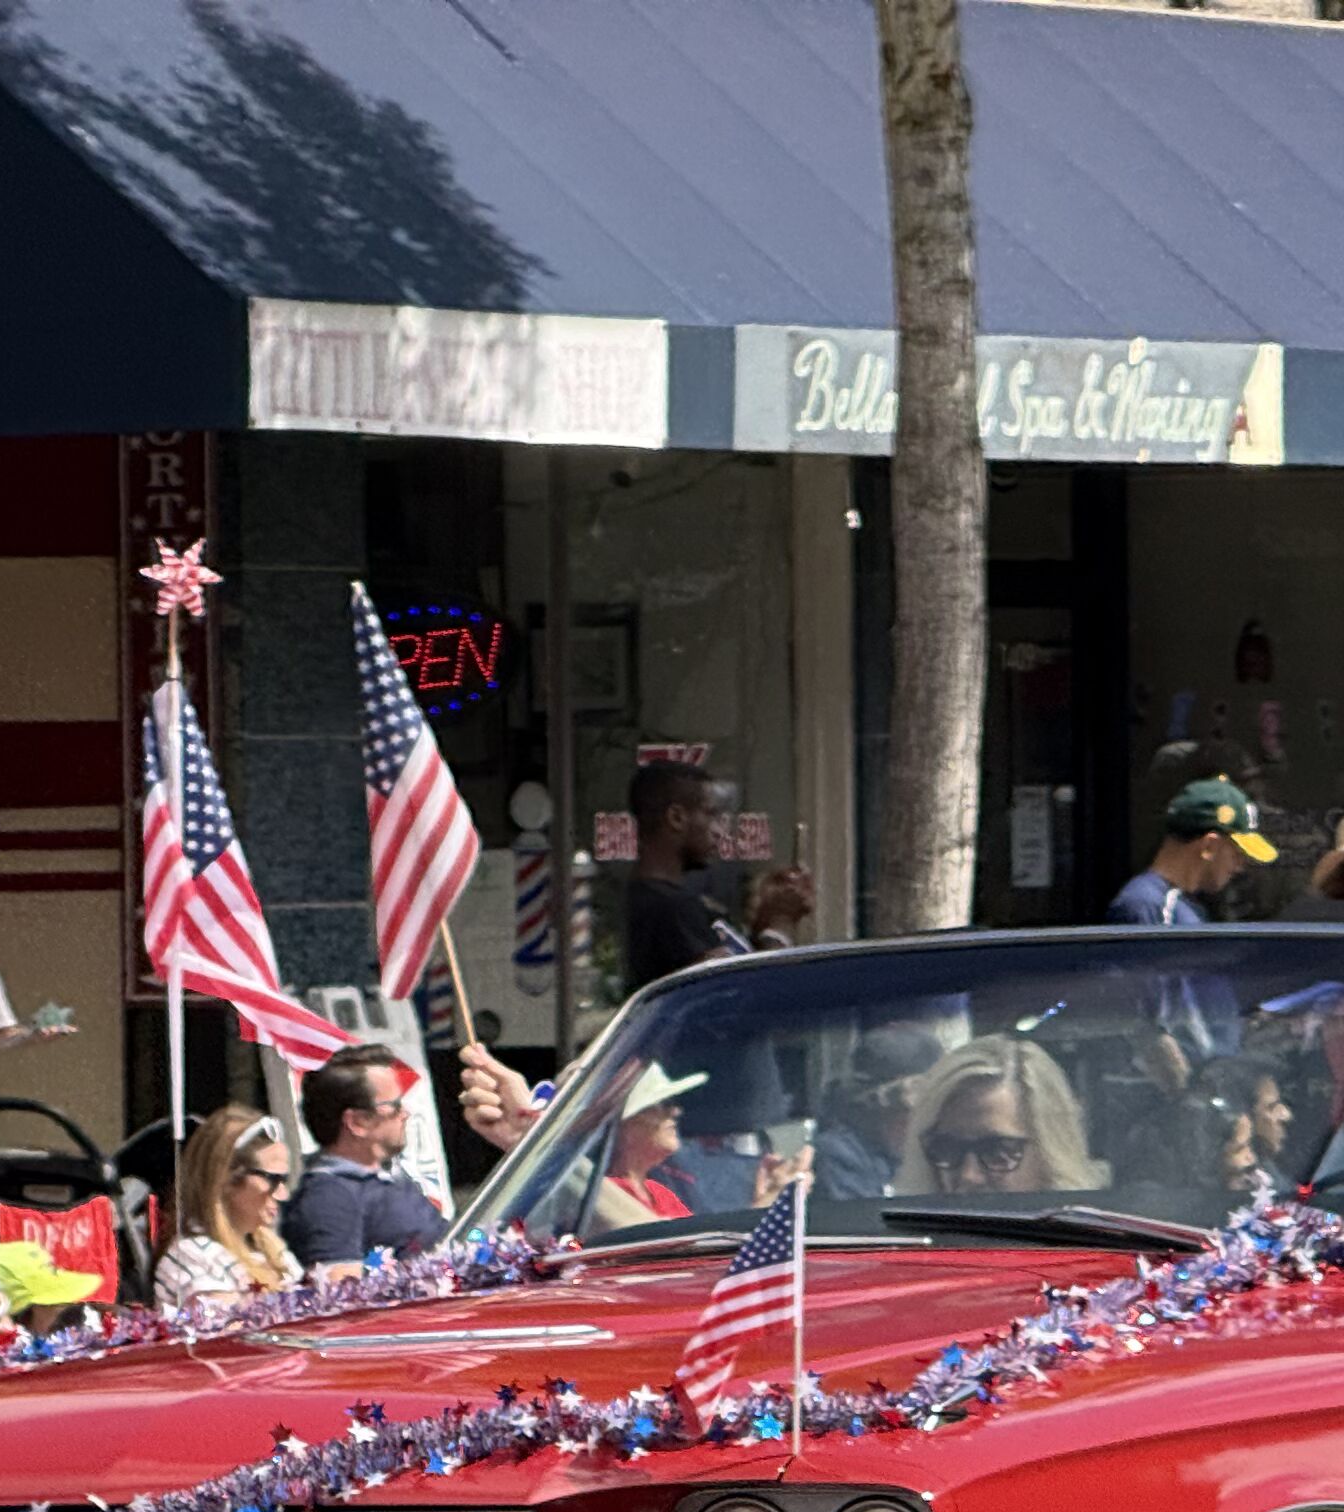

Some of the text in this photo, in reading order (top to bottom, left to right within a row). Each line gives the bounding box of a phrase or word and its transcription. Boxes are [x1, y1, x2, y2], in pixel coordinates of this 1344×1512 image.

[1000, 359, 1068, 455] Spa
[1073, 352, 1108, 440] &
[389, 622, 504, 691] PEN
